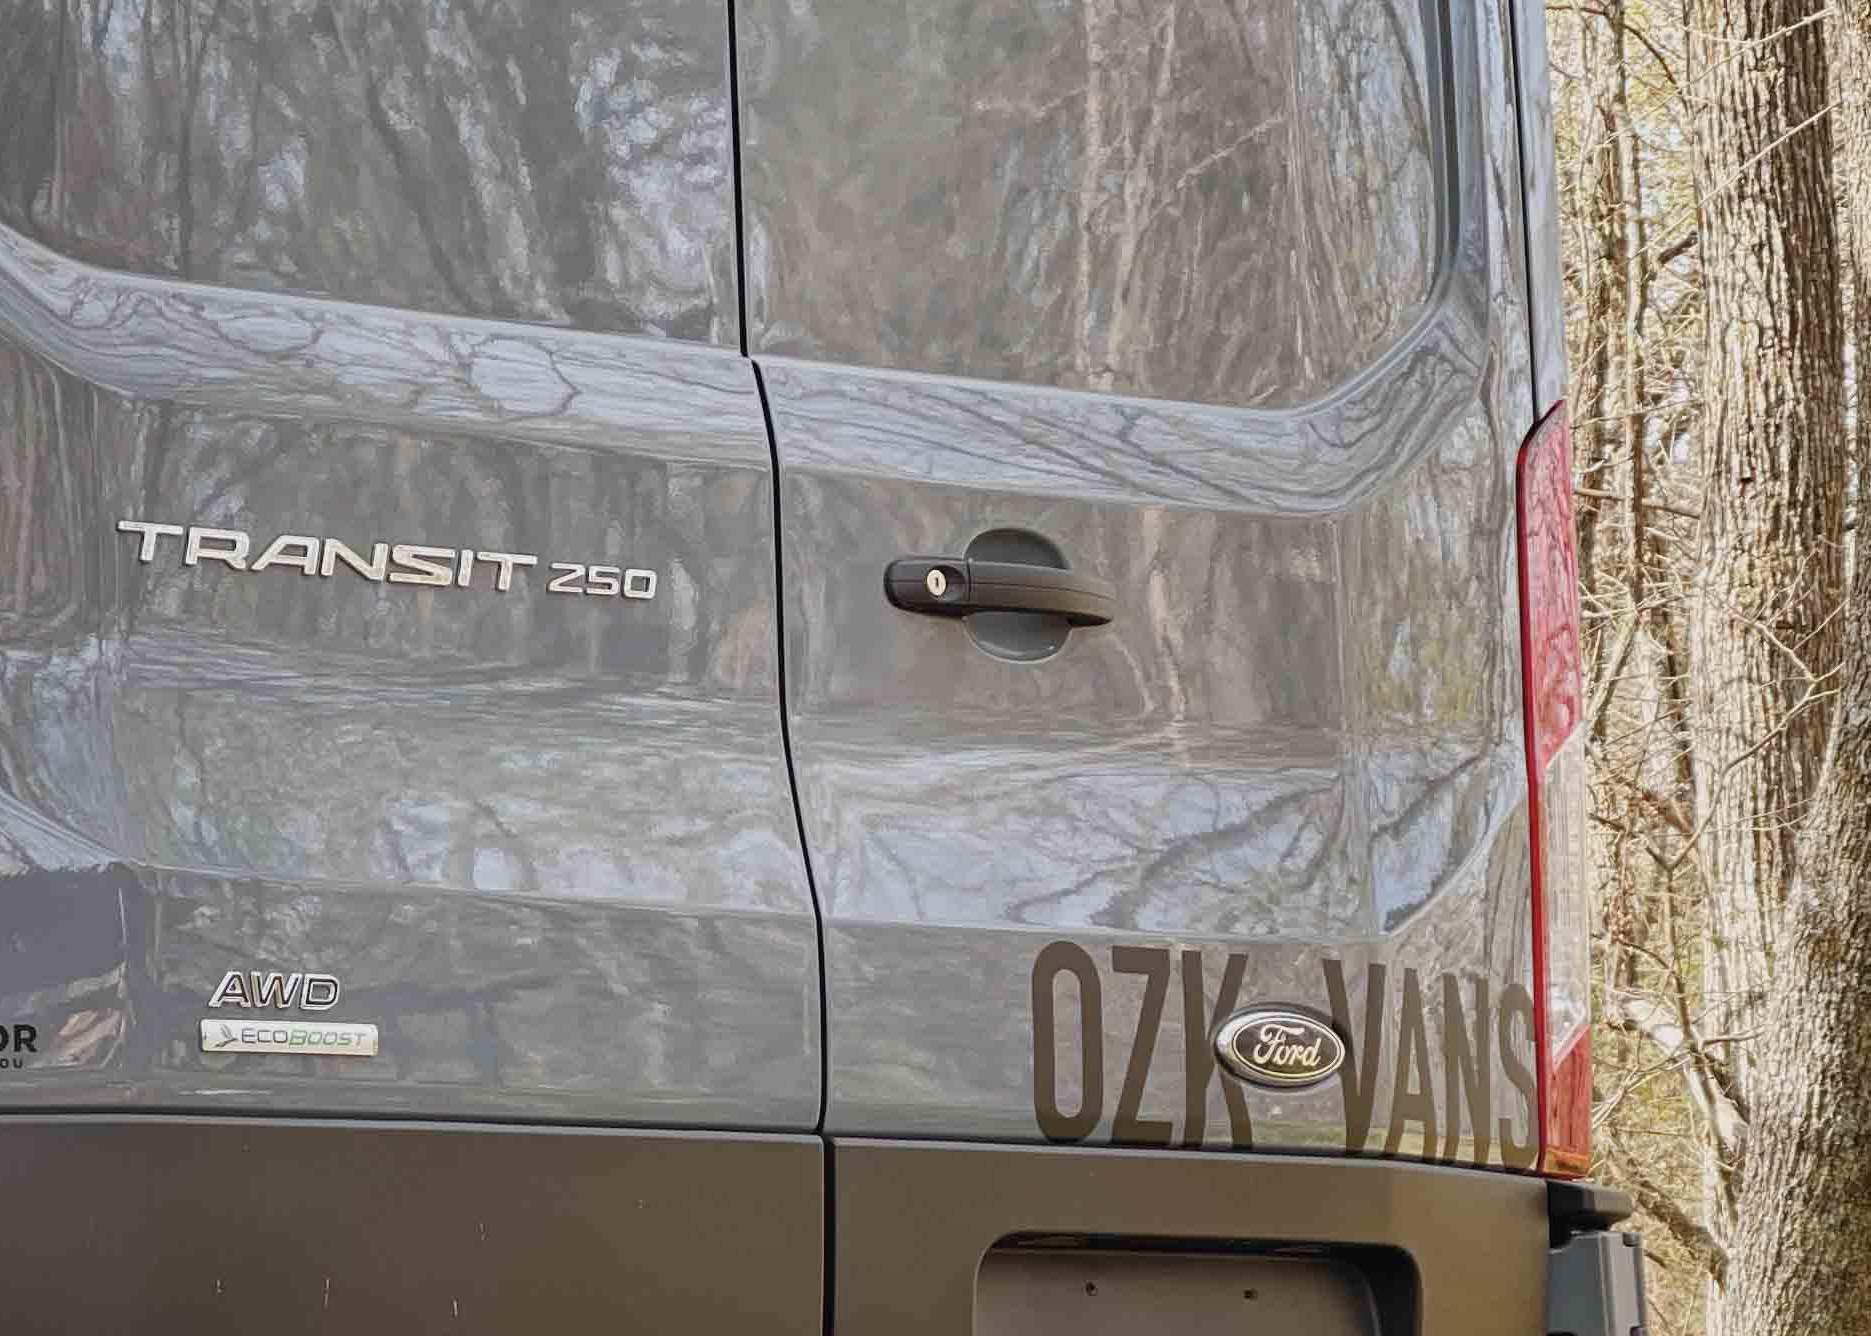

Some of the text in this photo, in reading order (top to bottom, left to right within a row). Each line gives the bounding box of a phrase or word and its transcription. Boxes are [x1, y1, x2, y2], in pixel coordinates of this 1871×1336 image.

[117, 520, 657, 599] TRANSIT 250
[208, 971, 340, 1011] AWD
[1032, 941, 1541, 1173] OZK VANS
[1253, 1023, 1323, 1067] Ford
